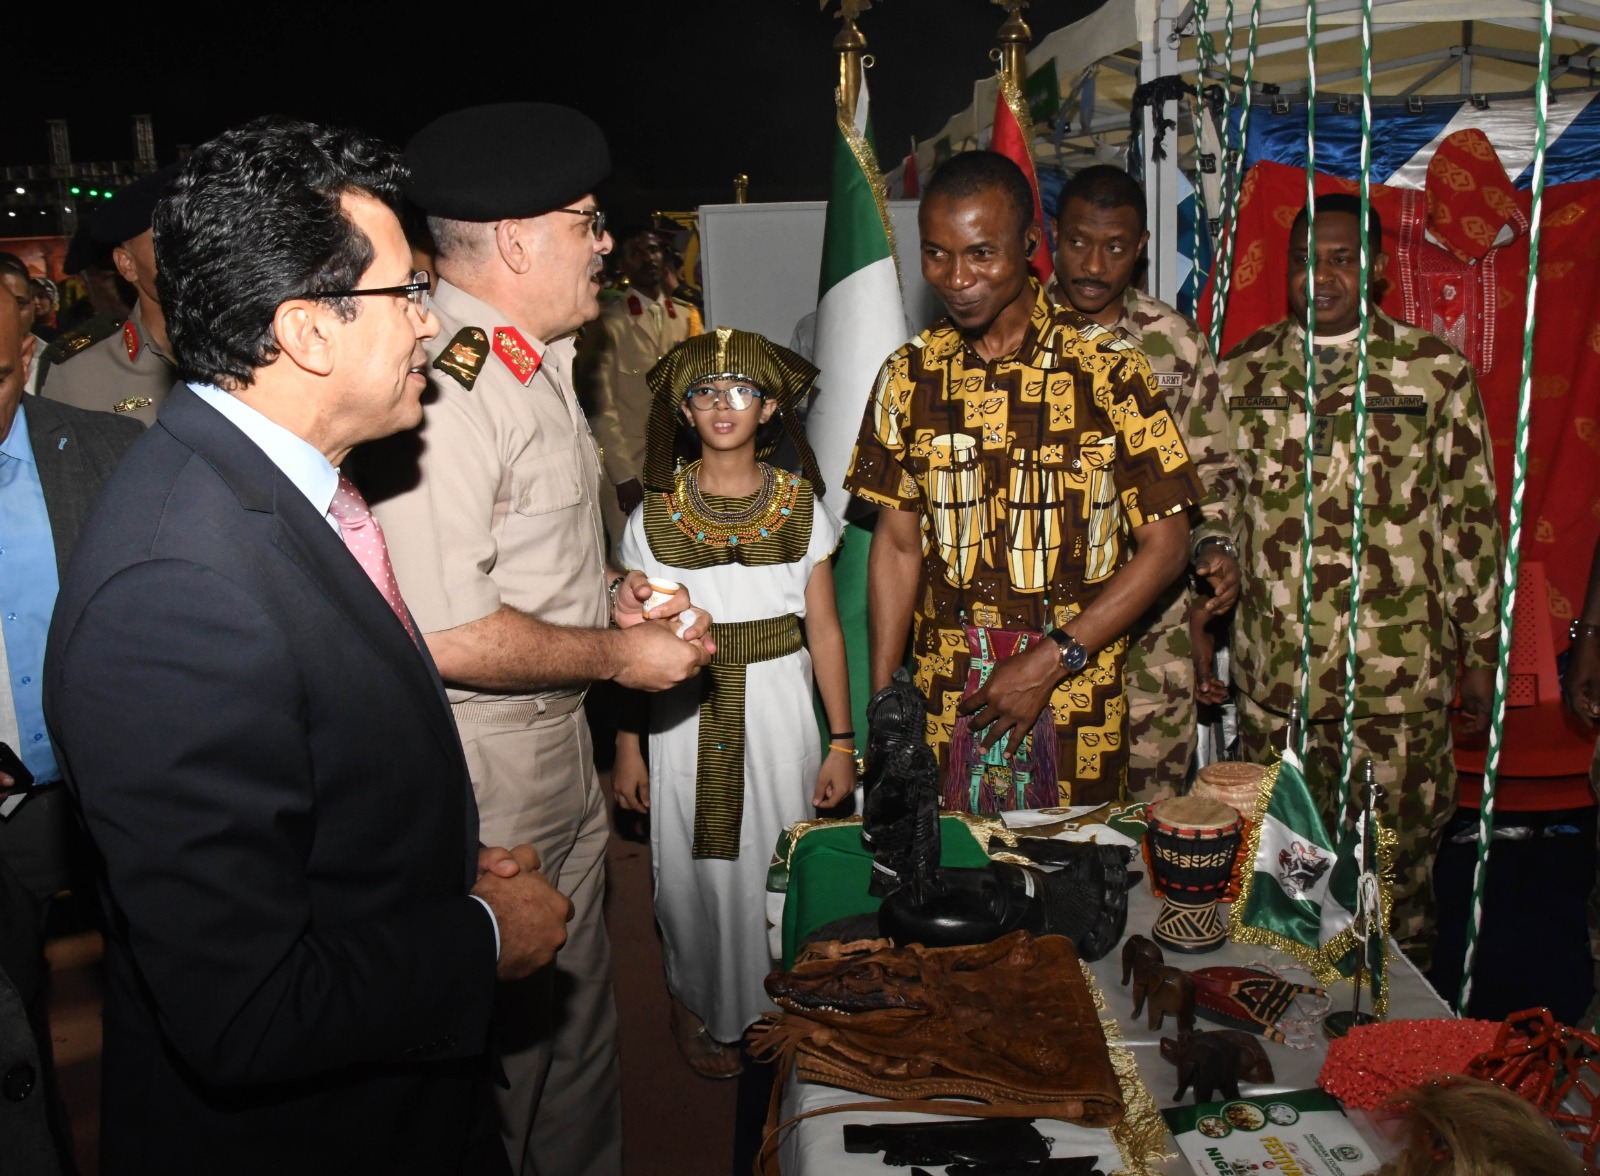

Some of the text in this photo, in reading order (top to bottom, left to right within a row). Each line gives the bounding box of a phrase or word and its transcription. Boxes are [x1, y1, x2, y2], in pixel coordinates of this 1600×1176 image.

[1161, 376, 1181, 385] ARMY
[1246, 398, 1278, 406] GARBA
[1398, 396, 1422, 407] ARMY
